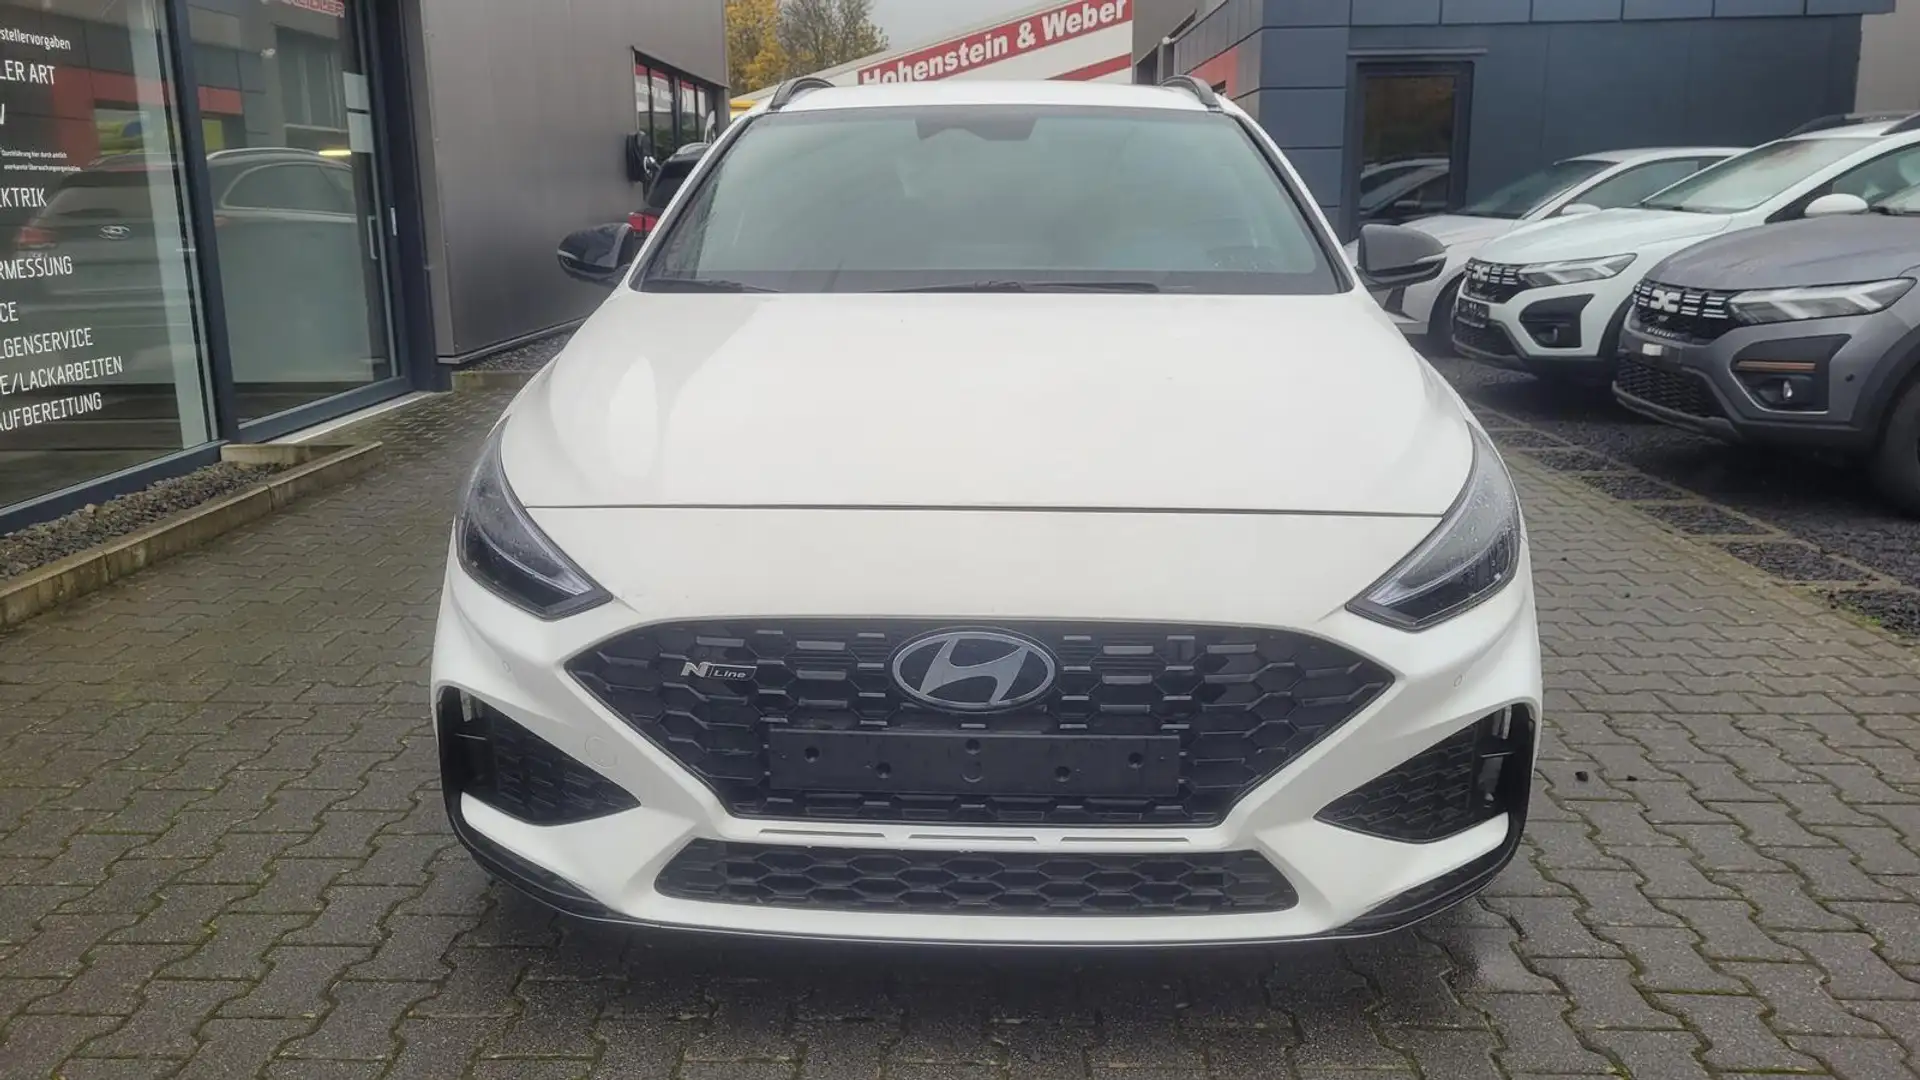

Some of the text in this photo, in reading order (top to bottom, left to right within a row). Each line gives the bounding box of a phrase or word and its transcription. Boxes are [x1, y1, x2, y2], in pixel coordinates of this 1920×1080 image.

[862, 0, 1127, 84] Hohenstein & Weber
[30, 63, 56, 85] ART
[0, 187, 47, 208] KTRIK
[713, 669, 747, 679] Line
